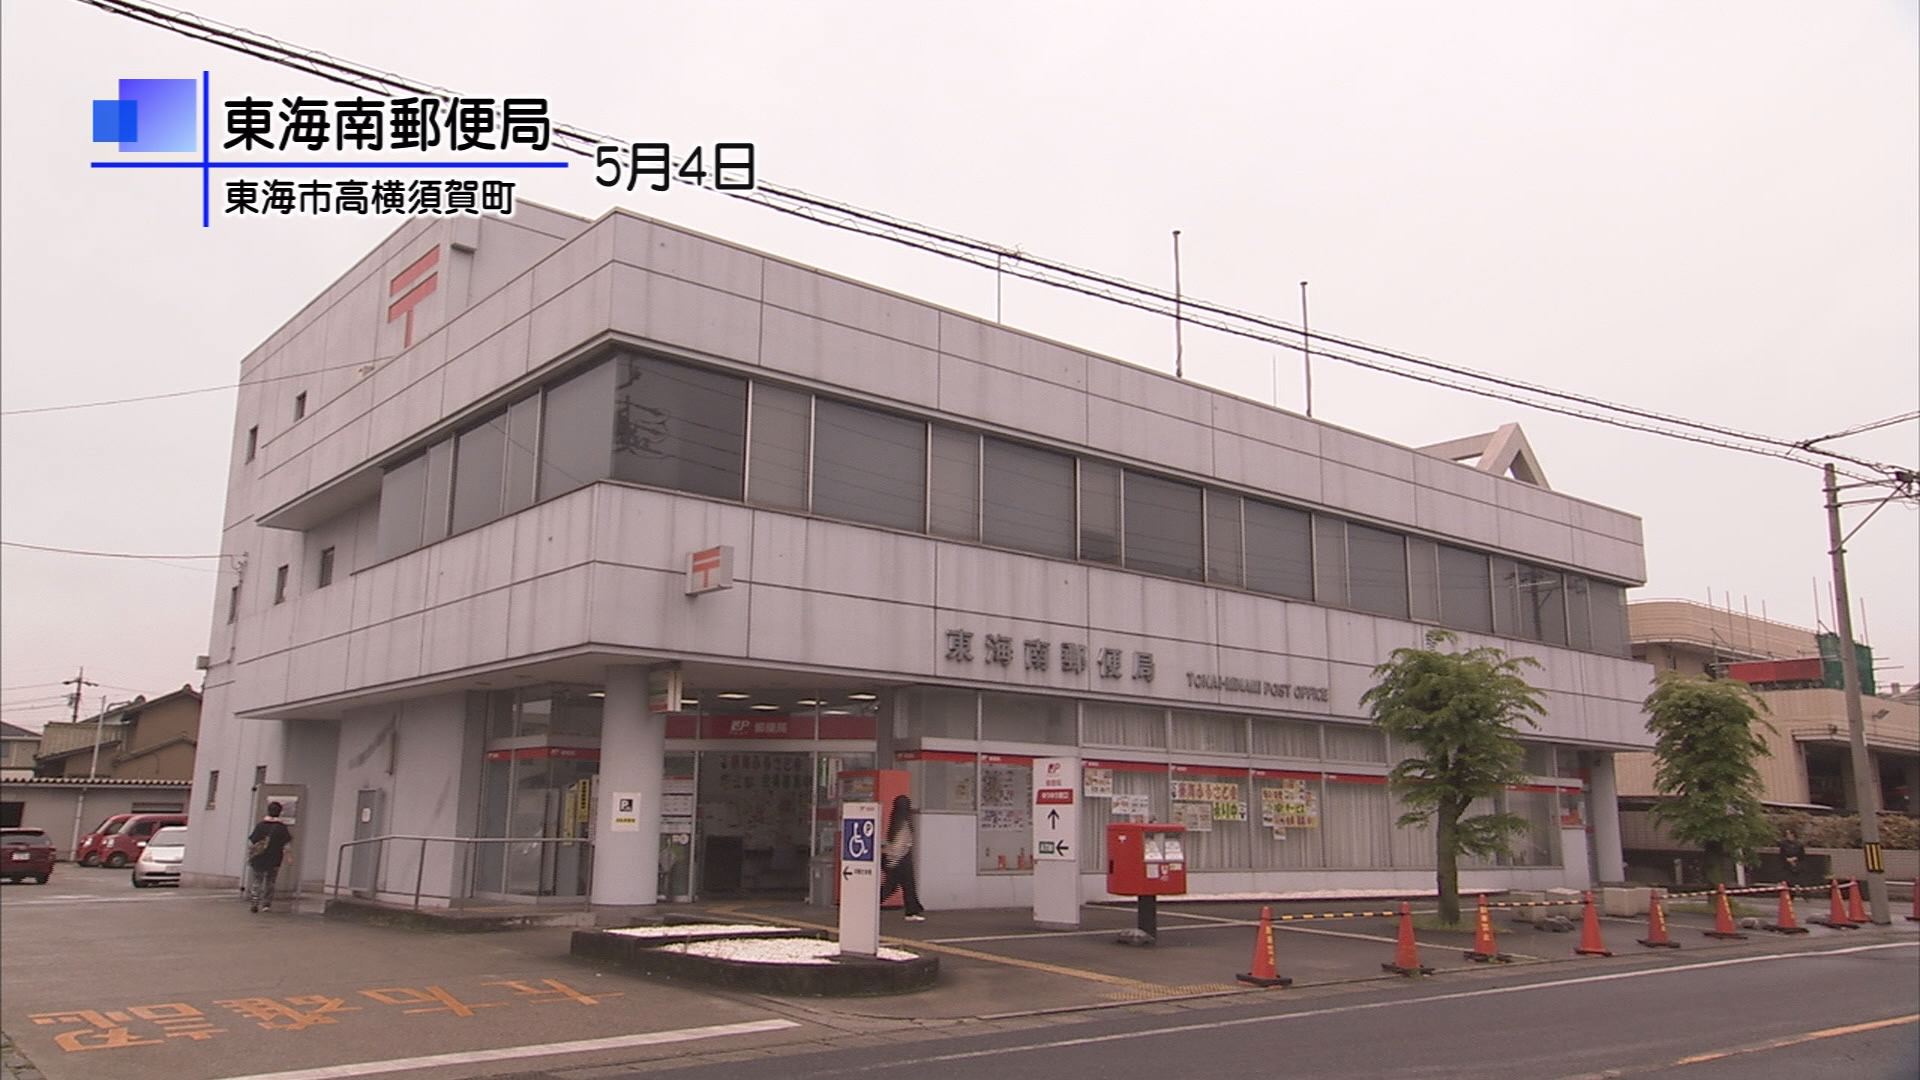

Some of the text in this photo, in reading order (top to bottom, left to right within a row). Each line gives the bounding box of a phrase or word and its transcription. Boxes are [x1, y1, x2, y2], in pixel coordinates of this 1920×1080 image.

[944, 628, 1157, 683] 東海南郵便局
[1263, 682, 1292, 699] POST
[1293, 685, 1330, 703] OFFICE
